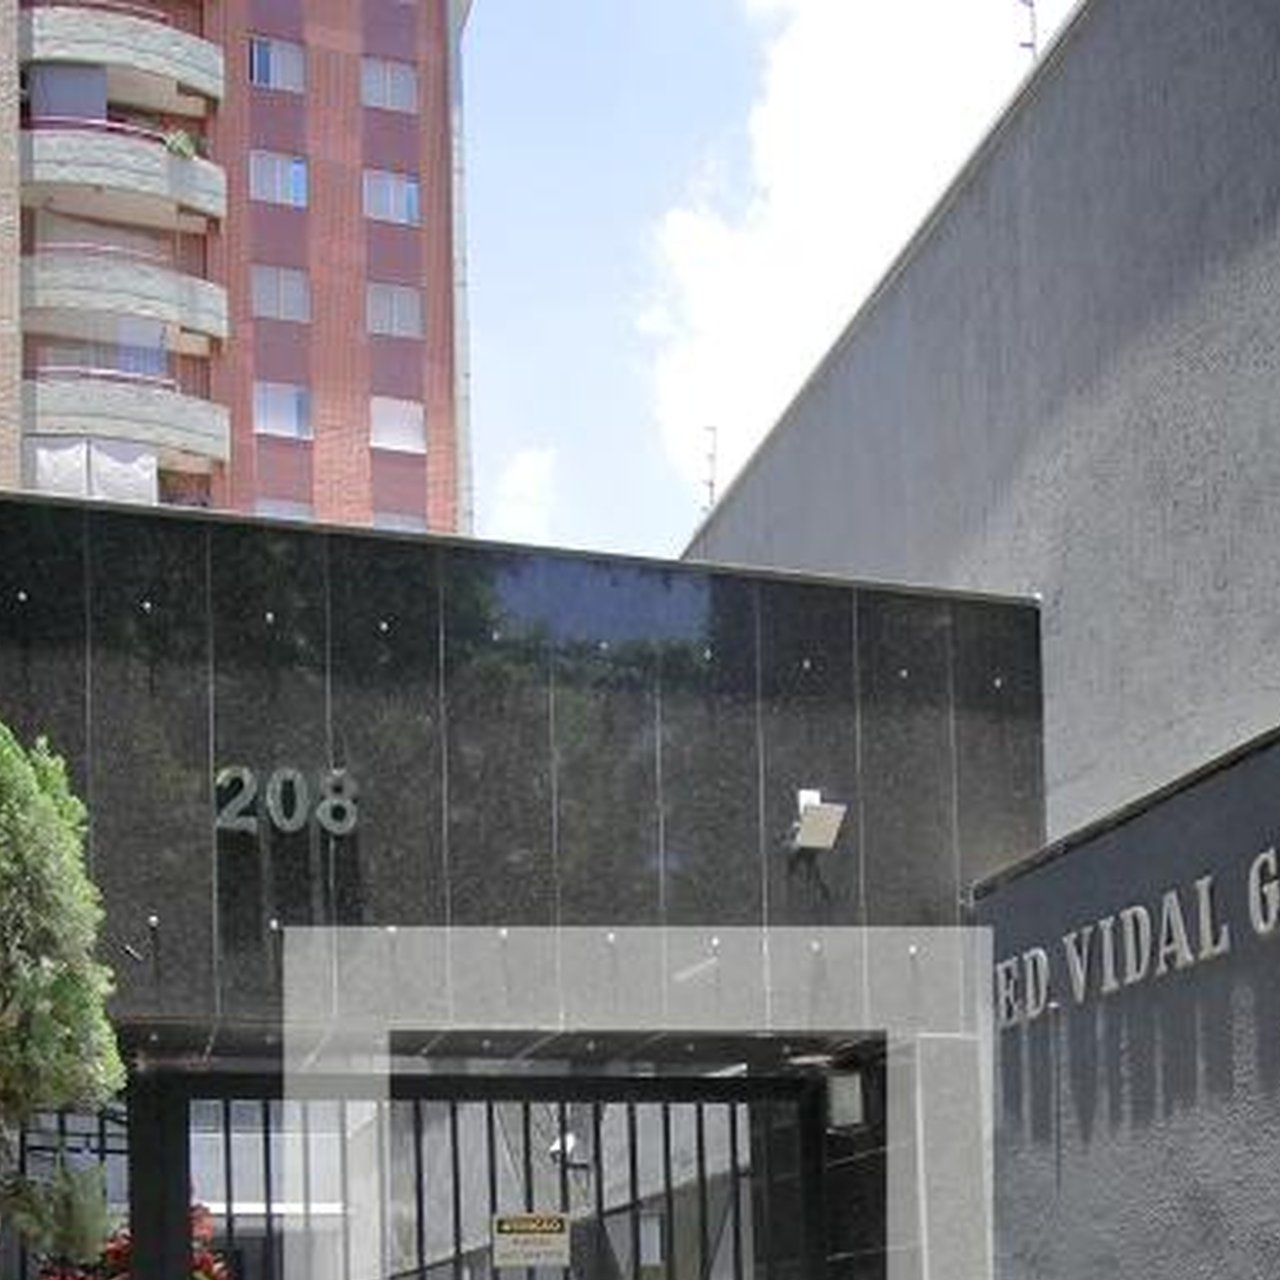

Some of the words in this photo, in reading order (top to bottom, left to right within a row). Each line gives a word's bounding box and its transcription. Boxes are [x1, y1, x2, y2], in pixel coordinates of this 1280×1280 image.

[215, 766, 358, 836] 208
[996, 948, 1060, 1028] ED.
[1062, 875, 1230, 1004] VIDAL
